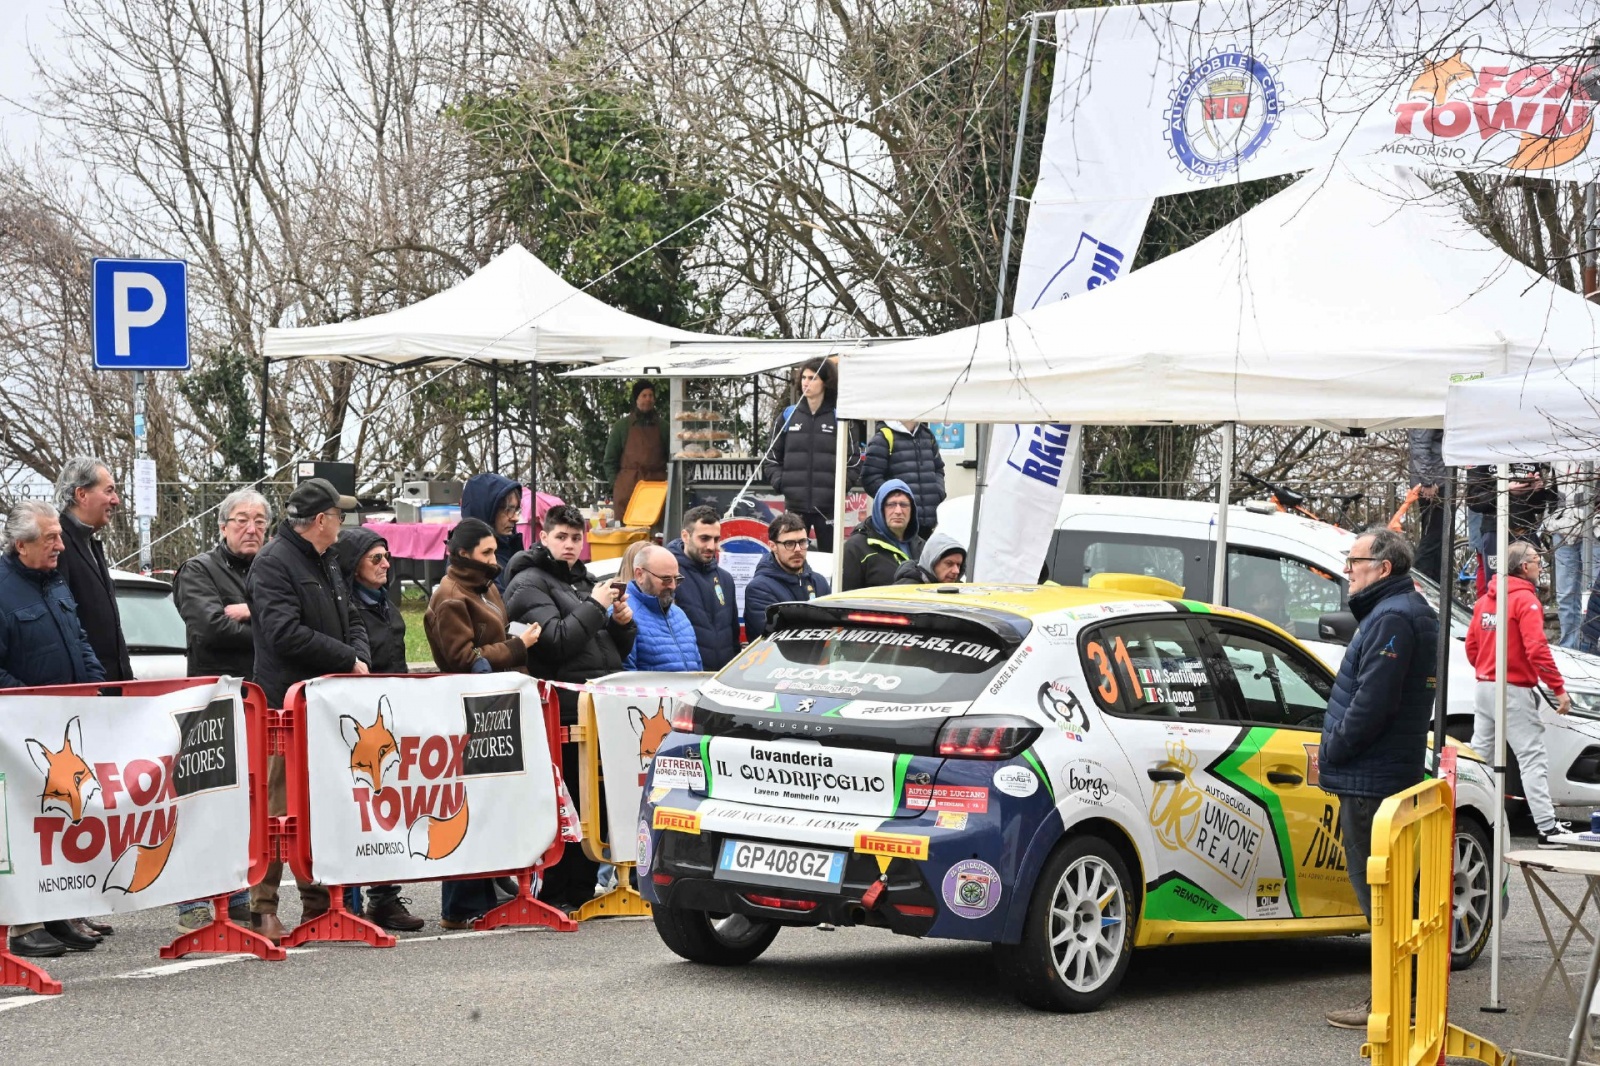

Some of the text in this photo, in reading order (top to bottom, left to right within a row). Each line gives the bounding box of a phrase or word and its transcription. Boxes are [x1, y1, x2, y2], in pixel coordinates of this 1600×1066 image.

[1172, 55, 1247, 131] AUTOMOBILE
[1262, 76, 1277, 124] CLUB
[1394, 101, 1590, 140] TOWN
[1381, 143, 1466, 159] MENDRISIO
[114, 272, 167, 356] P
[693, 463, 763, 481] AMERICAN
[765, 626, 1001, 663] VALSESIAMOTORS-RS.COM
[989, 671, 1010, 696] GRAZIE
[1087, 636, 1143, 704] 31
[1151, 668, 1208, 687] M.Sanfilippo
[862, 705, 953, 714] REMOTIVE
[1156, 687, 1195, 705] S.Longo
[473, 708, 513, 733] FACTORY
[758, 720, 834, 733] PEUGEOT
[398, 733, 472, 781] FOX
[468, 735, 514, 759] STORES
[750, 746, 833, 767] lavanderia
[178, 747, 225, 779] STORES
[657, 759, 702, 770] VETRERIA
[716, 760, 885, 792] IL QUADRIFOGLIO
[94, 753, 179, 809] FOX
[754, 787, 779, 796] Laveno
[823, 795, 840, 804] (VA)
[908, 788, 986, 799] AUTOSHOP LUCIANO
[1069, 768, 1109, 800] borgo
[353, 782, 464, 832] TOWN
[1205, 785, 1251, 817] AUTOSCUOLA
[656, 811, 696, 829] PIRELLI
[1204, 802, 1259, 855] UNIONE
[34, 805, 177, 865] TOWN
[356, 841, 405, 857] MENDRISIO
[860, 834, 922, 855] PIRELLI
[736, 845, 830, 878] GP408GZ
[1196, 827, 1250, 880] REALI
[38, 874, 97, 893] MENDRISIO
[1173, 885, 1219, 914] REMOTIVE
